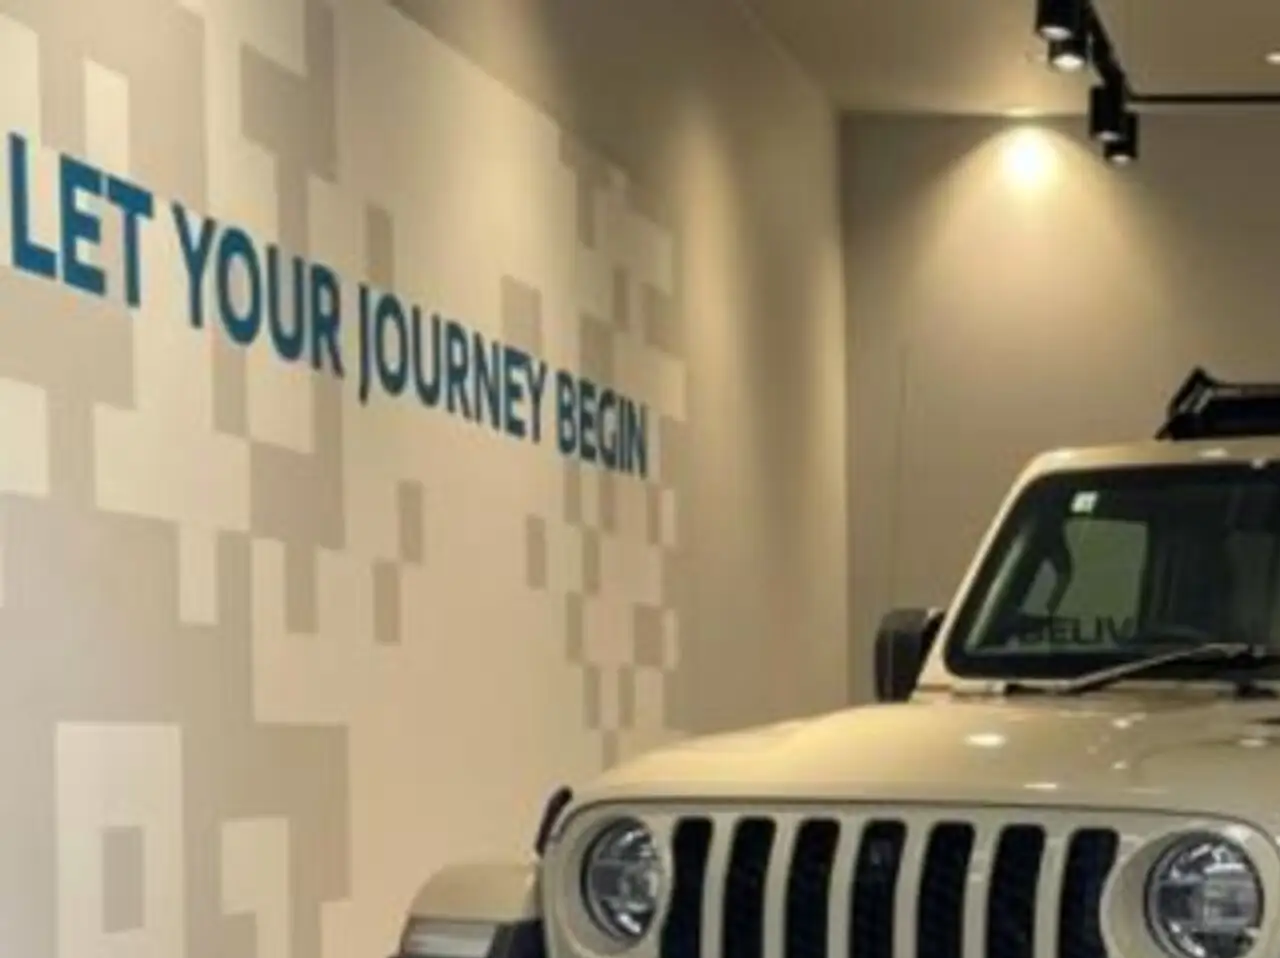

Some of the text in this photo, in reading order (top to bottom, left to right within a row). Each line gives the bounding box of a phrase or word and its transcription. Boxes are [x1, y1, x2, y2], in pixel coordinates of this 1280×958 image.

[9, 132, 648, 478] LET YOUR JOURNEY BEGIN
